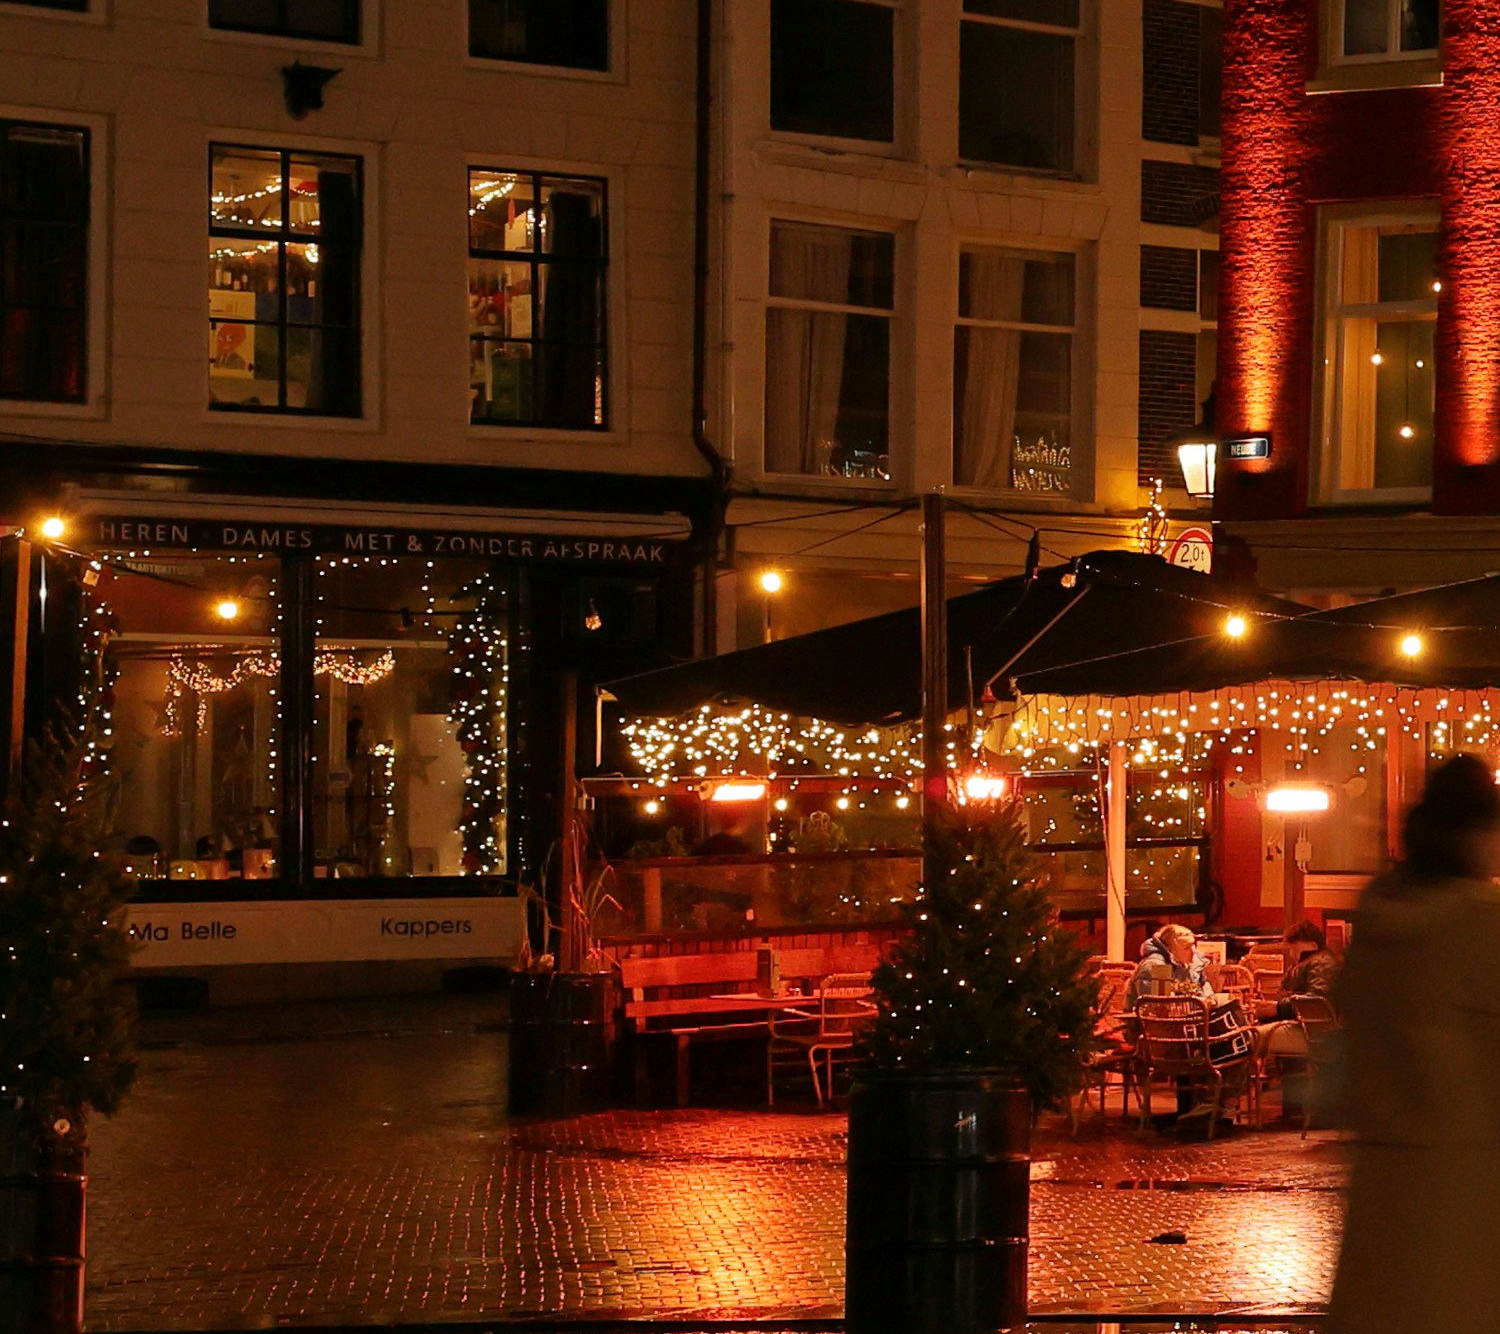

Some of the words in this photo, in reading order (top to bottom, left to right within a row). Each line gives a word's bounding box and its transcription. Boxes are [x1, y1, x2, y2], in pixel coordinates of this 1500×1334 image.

[100, 521, 189, 544] HEREN
[222, 527, 313, 548] DAMES
[343, 531, 395, 552] MET
[406, 534, 423, 553] &
[130, 922, 168, 941] Ma
[181, 920, 237, 941] Belle
[381, 917, 472, 940] Kappers
